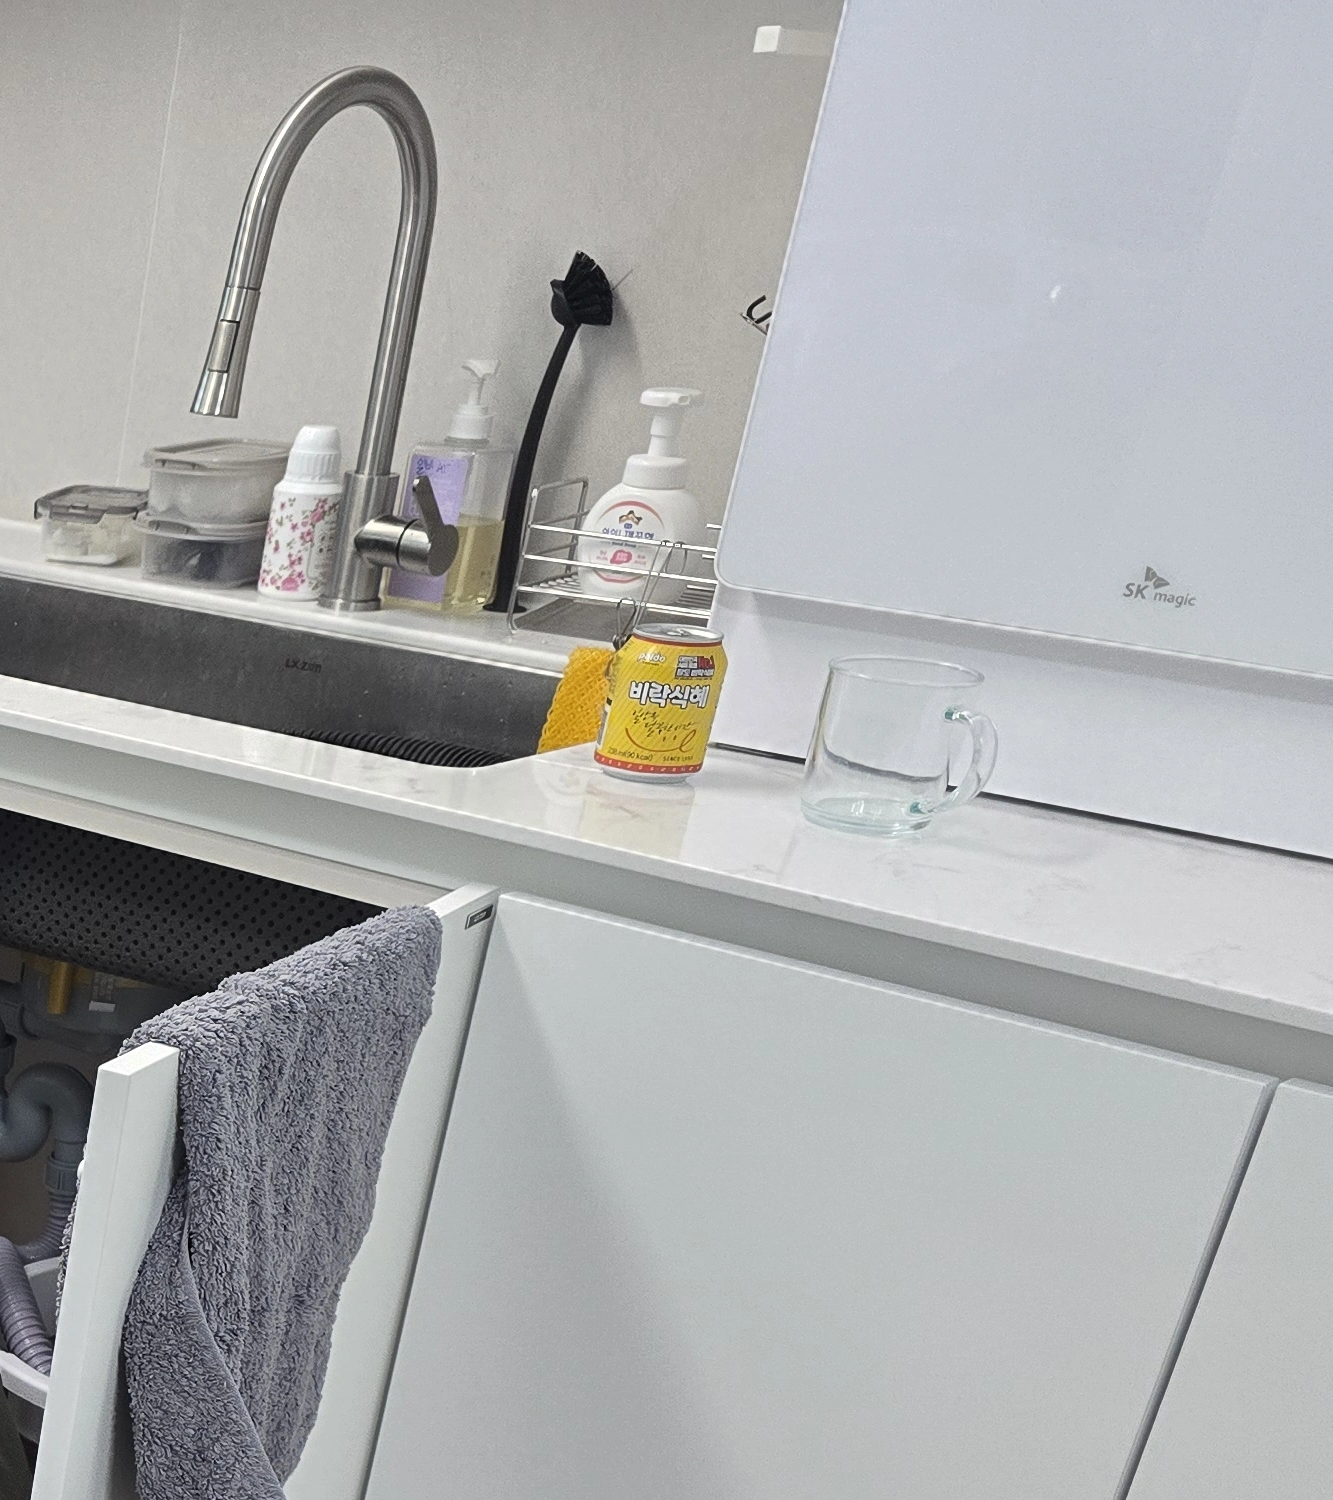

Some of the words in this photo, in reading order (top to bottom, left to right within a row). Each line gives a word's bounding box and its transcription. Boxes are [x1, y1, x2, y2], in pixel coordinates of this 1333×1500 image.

[1122, 582, 1149, 600] SK
[1153, 592, 1197, 608] magic
[629, 681, 710, 709] 비락식혜
